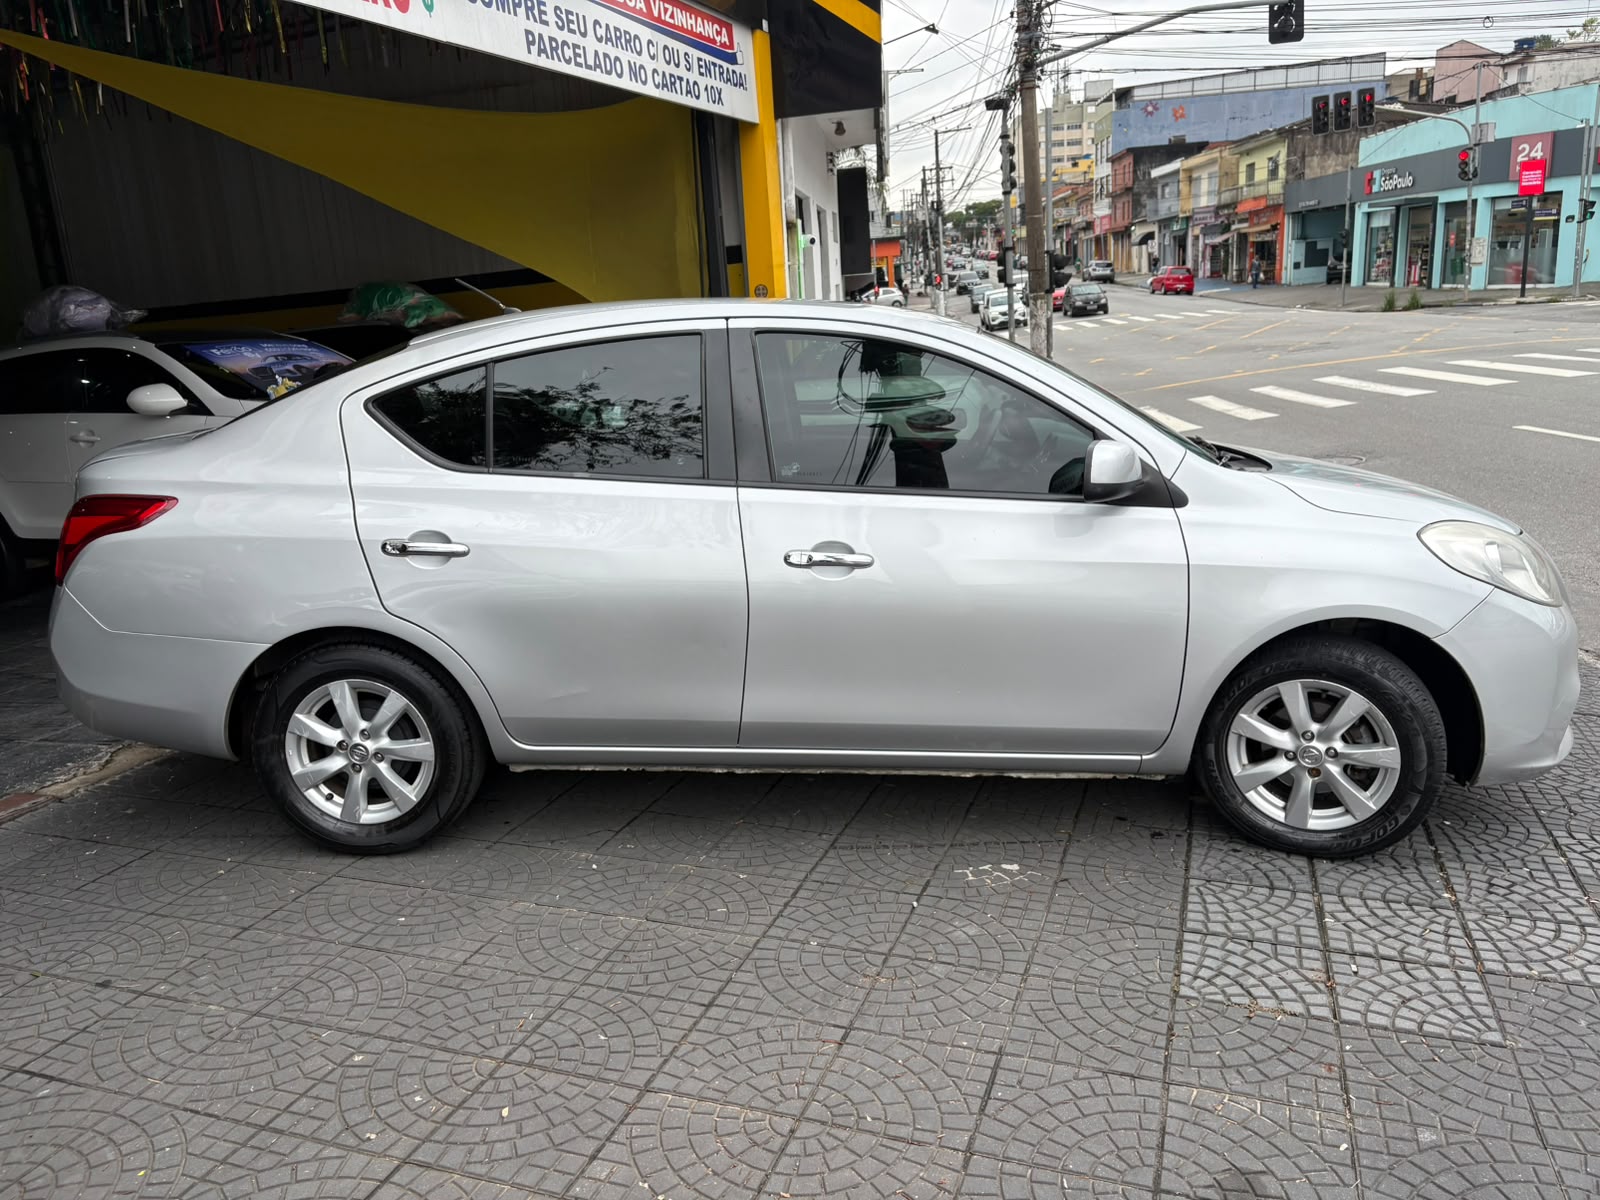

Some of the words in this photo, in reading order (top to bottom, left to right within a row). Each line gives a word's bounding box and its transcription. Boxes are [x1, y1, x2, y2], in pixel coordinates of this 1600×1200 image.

[468, 0, 549, 26] MPRE
[554, 5, 588, 39] SEU
[593, 18, 643, 57] CARRO
[647, 39, 659, 63] C/
[663, 44, 681, 69] OU
[684, 52, 694, 74] S/
[697, 57, 748, 91] ENTRADA!
[650, 0, 730, 47] VIZINHANÇA
[524, 29, 624, 79] PARCELADO
[627, 60, 648, 86] NO
[652, 68, 700, 100] CARTAO
[704, 83, 724, 106] 10X
[1516, 141, 1543, 162] 24
